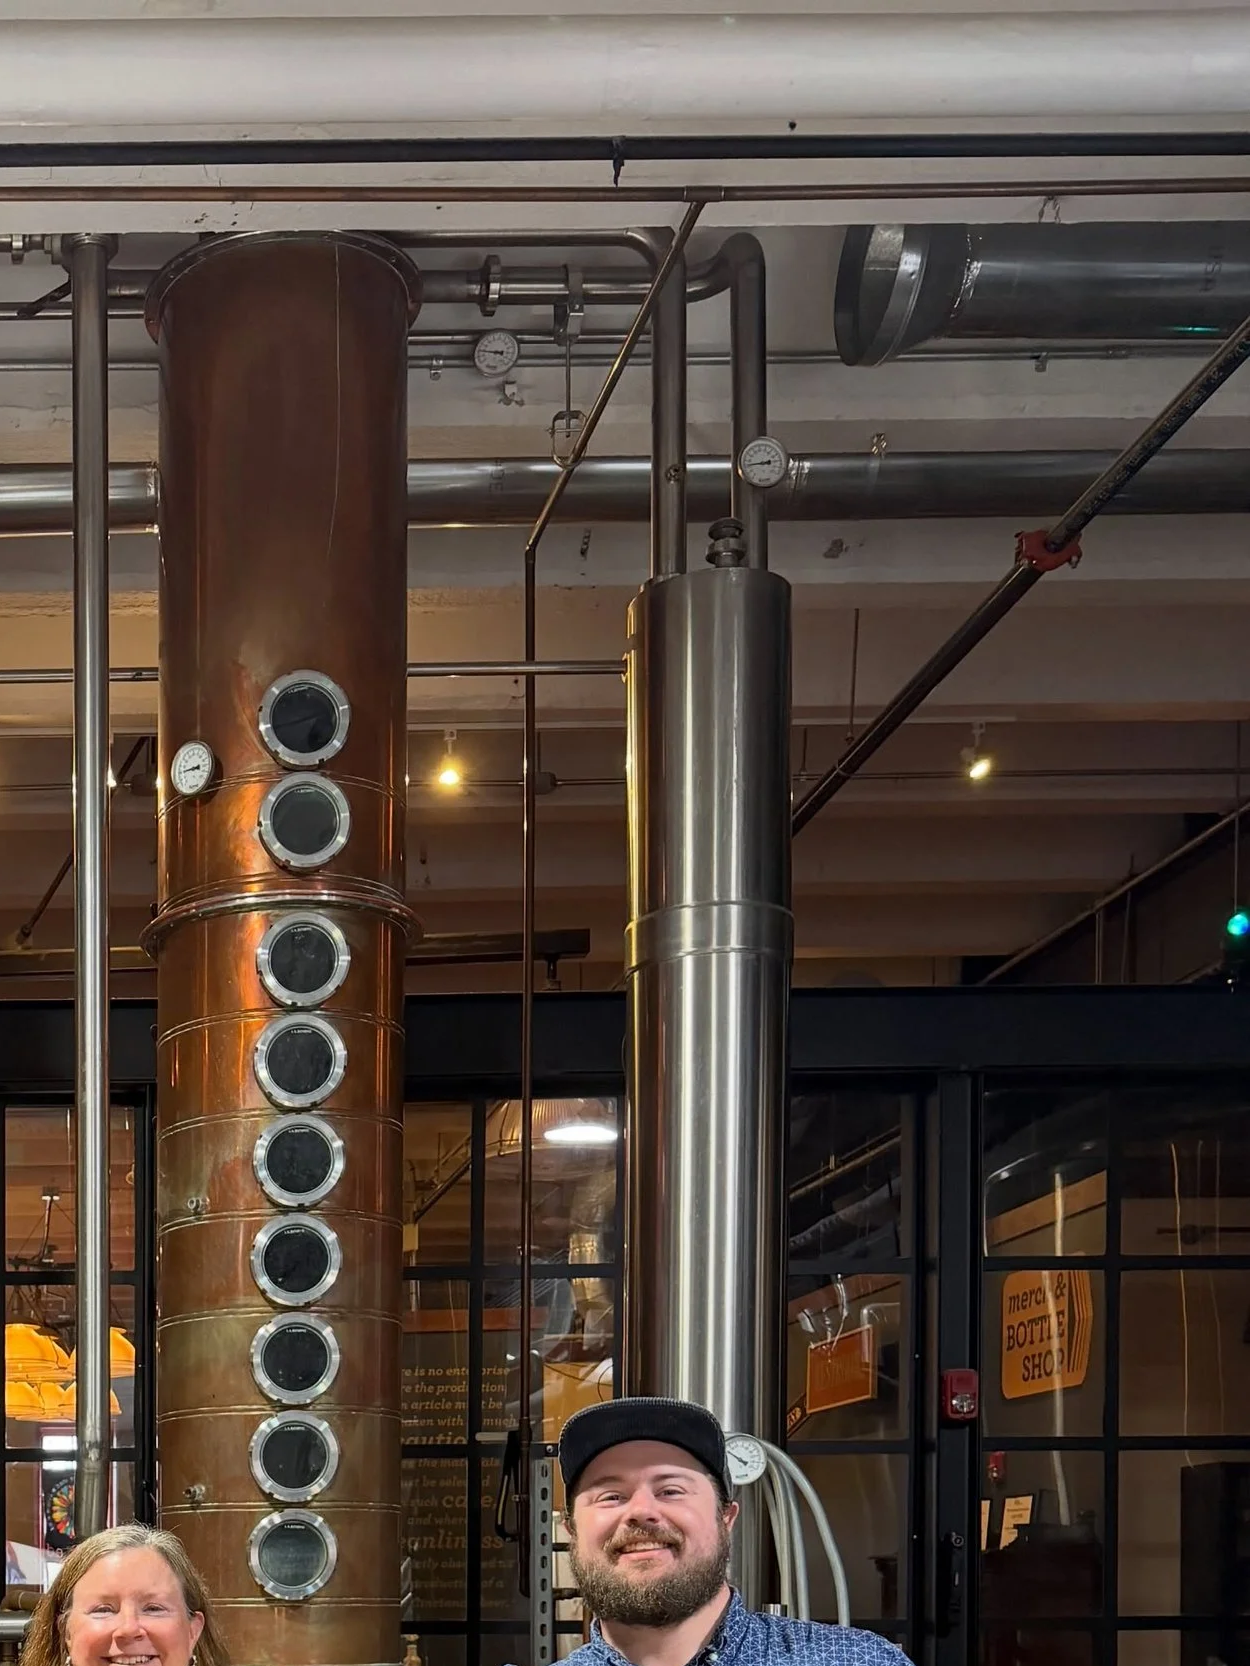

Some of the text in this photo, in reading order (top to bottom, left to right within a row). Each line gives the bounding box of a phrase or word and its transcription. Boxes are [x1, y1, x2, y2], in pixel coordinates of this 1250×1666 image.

[1008, 1272, 1067, 1315] merc &
[415, 1382, 434, 1393] the
[488, 1398, 503, 1410] be
[437, 1414, 463, 1427] with
[442, 1495, 497, 1509] cae,
